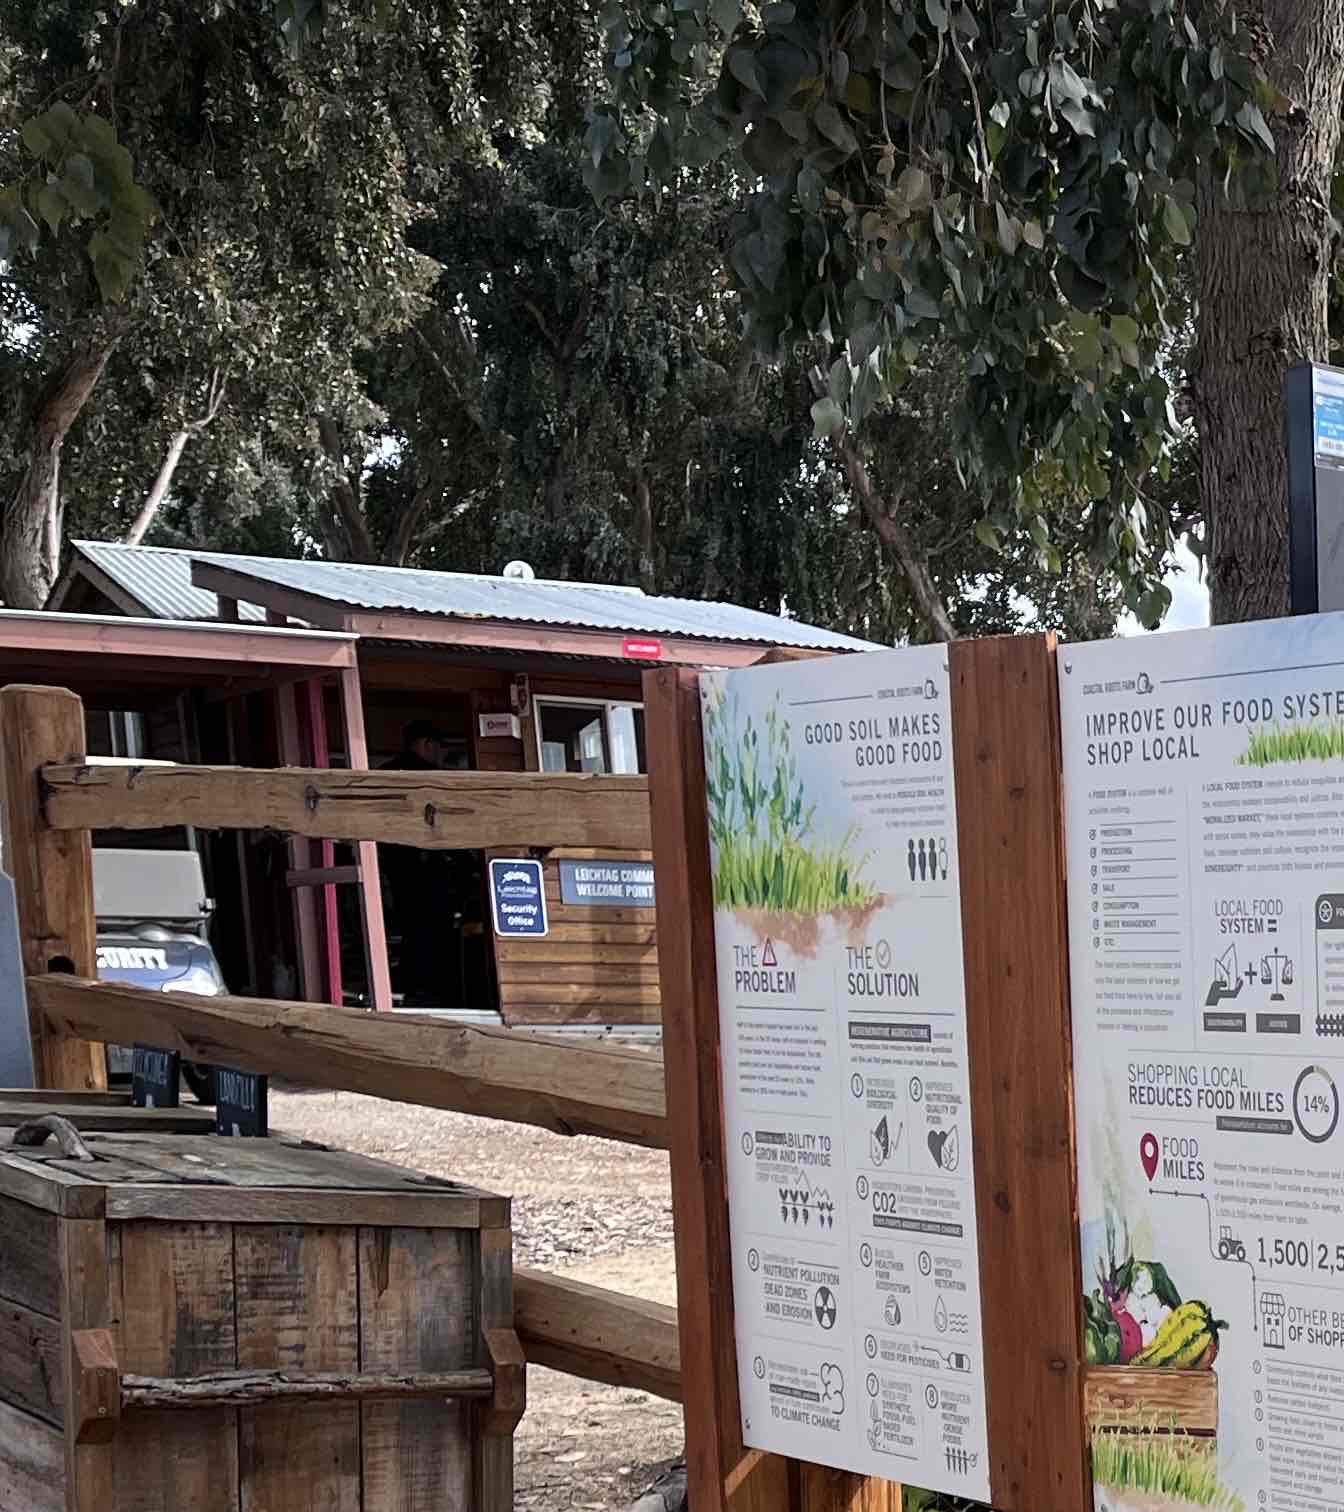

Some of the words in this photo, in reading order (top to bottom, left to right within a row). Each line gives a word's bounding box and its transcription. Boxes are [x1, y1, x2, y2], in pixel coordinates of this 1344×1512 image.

[803, 721, 844, 746] GOOD
[847, 718, 884, 743] SOIL
[887, 711, 942, 739] MAKES
[1084, 706, 1167, 738] IMPROVE
[1172, 702, 1213, 731] OUR
[1221, 696, 1277, 727] FOOD
[854, 742, 897, 769] GOOD
[901, 739, 944, 765] FOOD
[1086, 739, 1135, 767] SHOP
[1141, 734, 1201, 763] LOCAL
[576, 883, 624, 897] WELCOME
[500, 903, 538, 916] Security
[507, 916, 534, 927] Office
[1213, 898, 1251, 920] LOCAL
[1247, 897, 1285, 920] FOOD
[1218, 916, 1265, 935] SYSTEM
[731, 943, 761, 970] THE
[843, 944, 876, 972] THE
[733, 969, 797, 995] PROBLEM
[846, 971, 921, 999] SOLUTION
[1126, 1062, 1200, 1088] SHOPPING
[1198, 1065, 1249, 1091] LOCAL
[1127, 1083, 1194, 1109] REDUCES
[1196, 1087, 1236, 1111] FOOD
[1238, 1089, 1286, 1114] MILES
[1302, 1094, 1331, 1115] 14%
[1160, 1135, 1202, 1161] FOOD
[1161, 1156, 1206, 1183] MILES
[1256, 1236, 1310, 1269] 1,500
[1285, 1304, 1332, 1330] OTHER
[1286, 1323, 1306, 1344] OF
[769, 1403, 782, 1420] TO
[779, 1406, 812, 1426] CLIMATE
[809, 1412, 842, 1433] CHANGE
